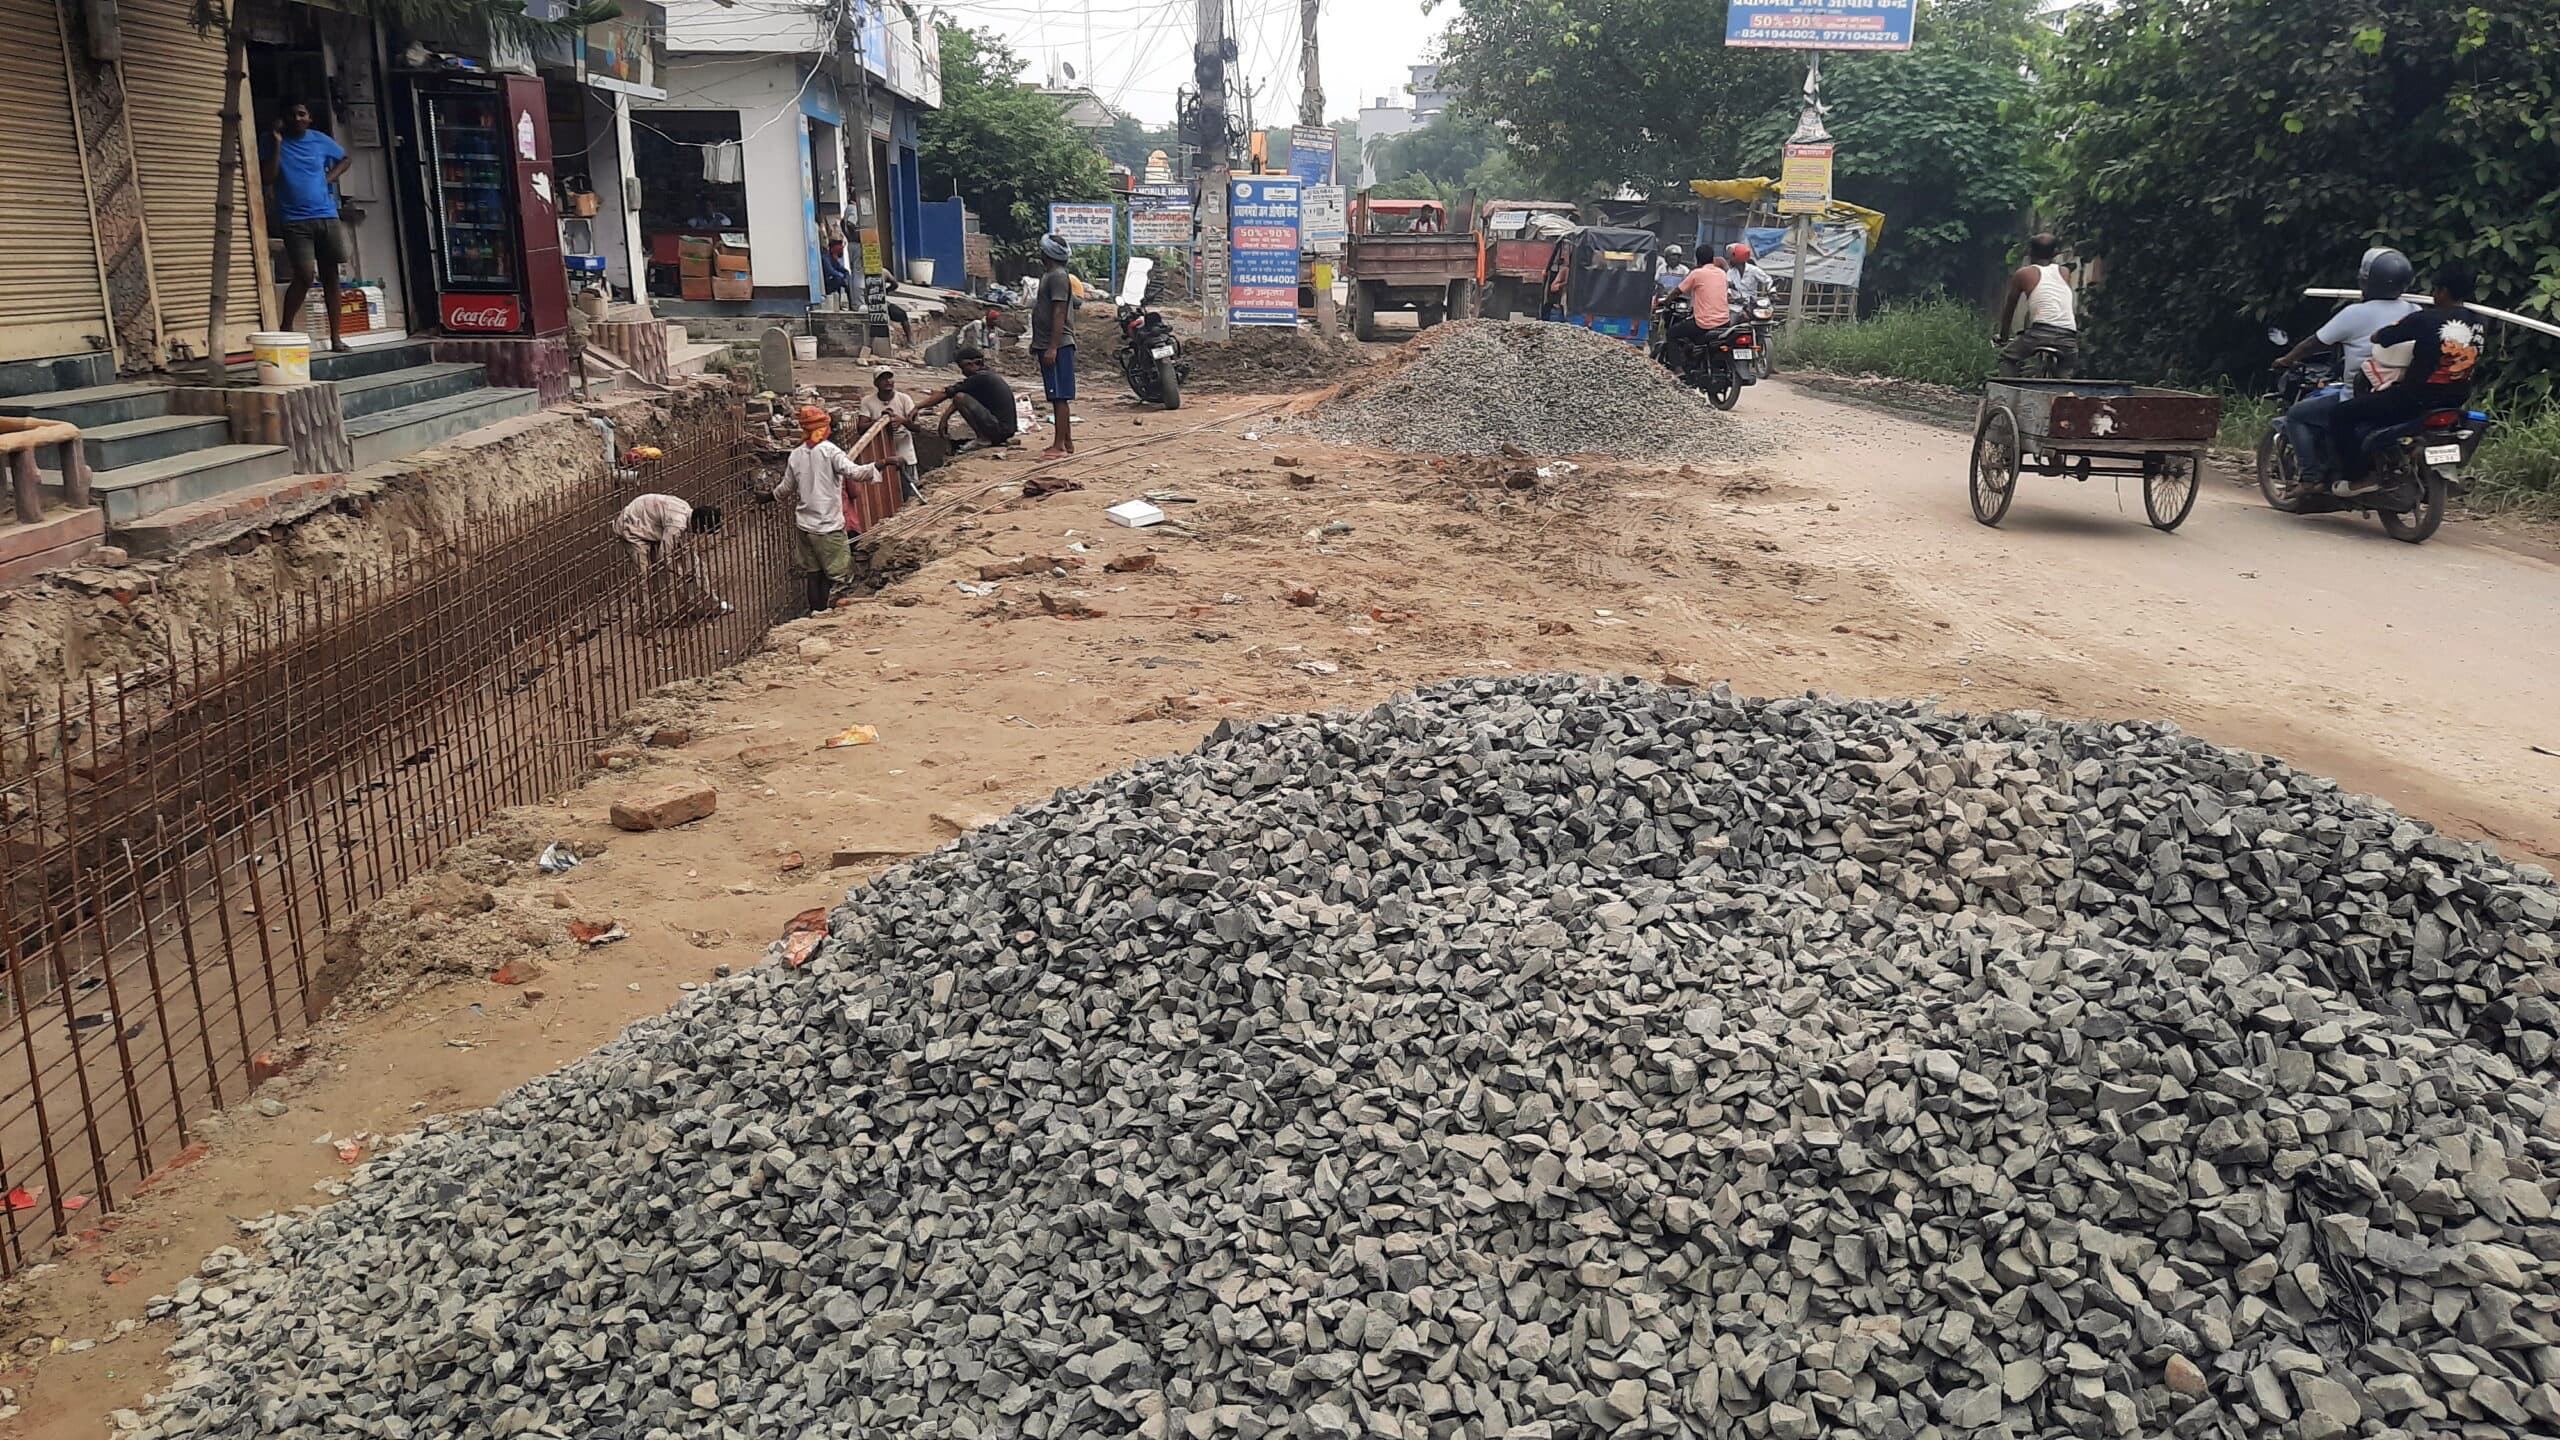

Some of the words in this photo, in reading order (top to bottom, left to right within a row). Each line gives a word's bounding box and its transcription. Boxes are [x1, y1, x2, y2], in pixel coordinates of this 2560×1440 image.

[1168, 186, 1189, 196] INDIA
[1240, 274, 1296, 284] 8541944002
[451, 307, 510, 327] Coca-Cola
